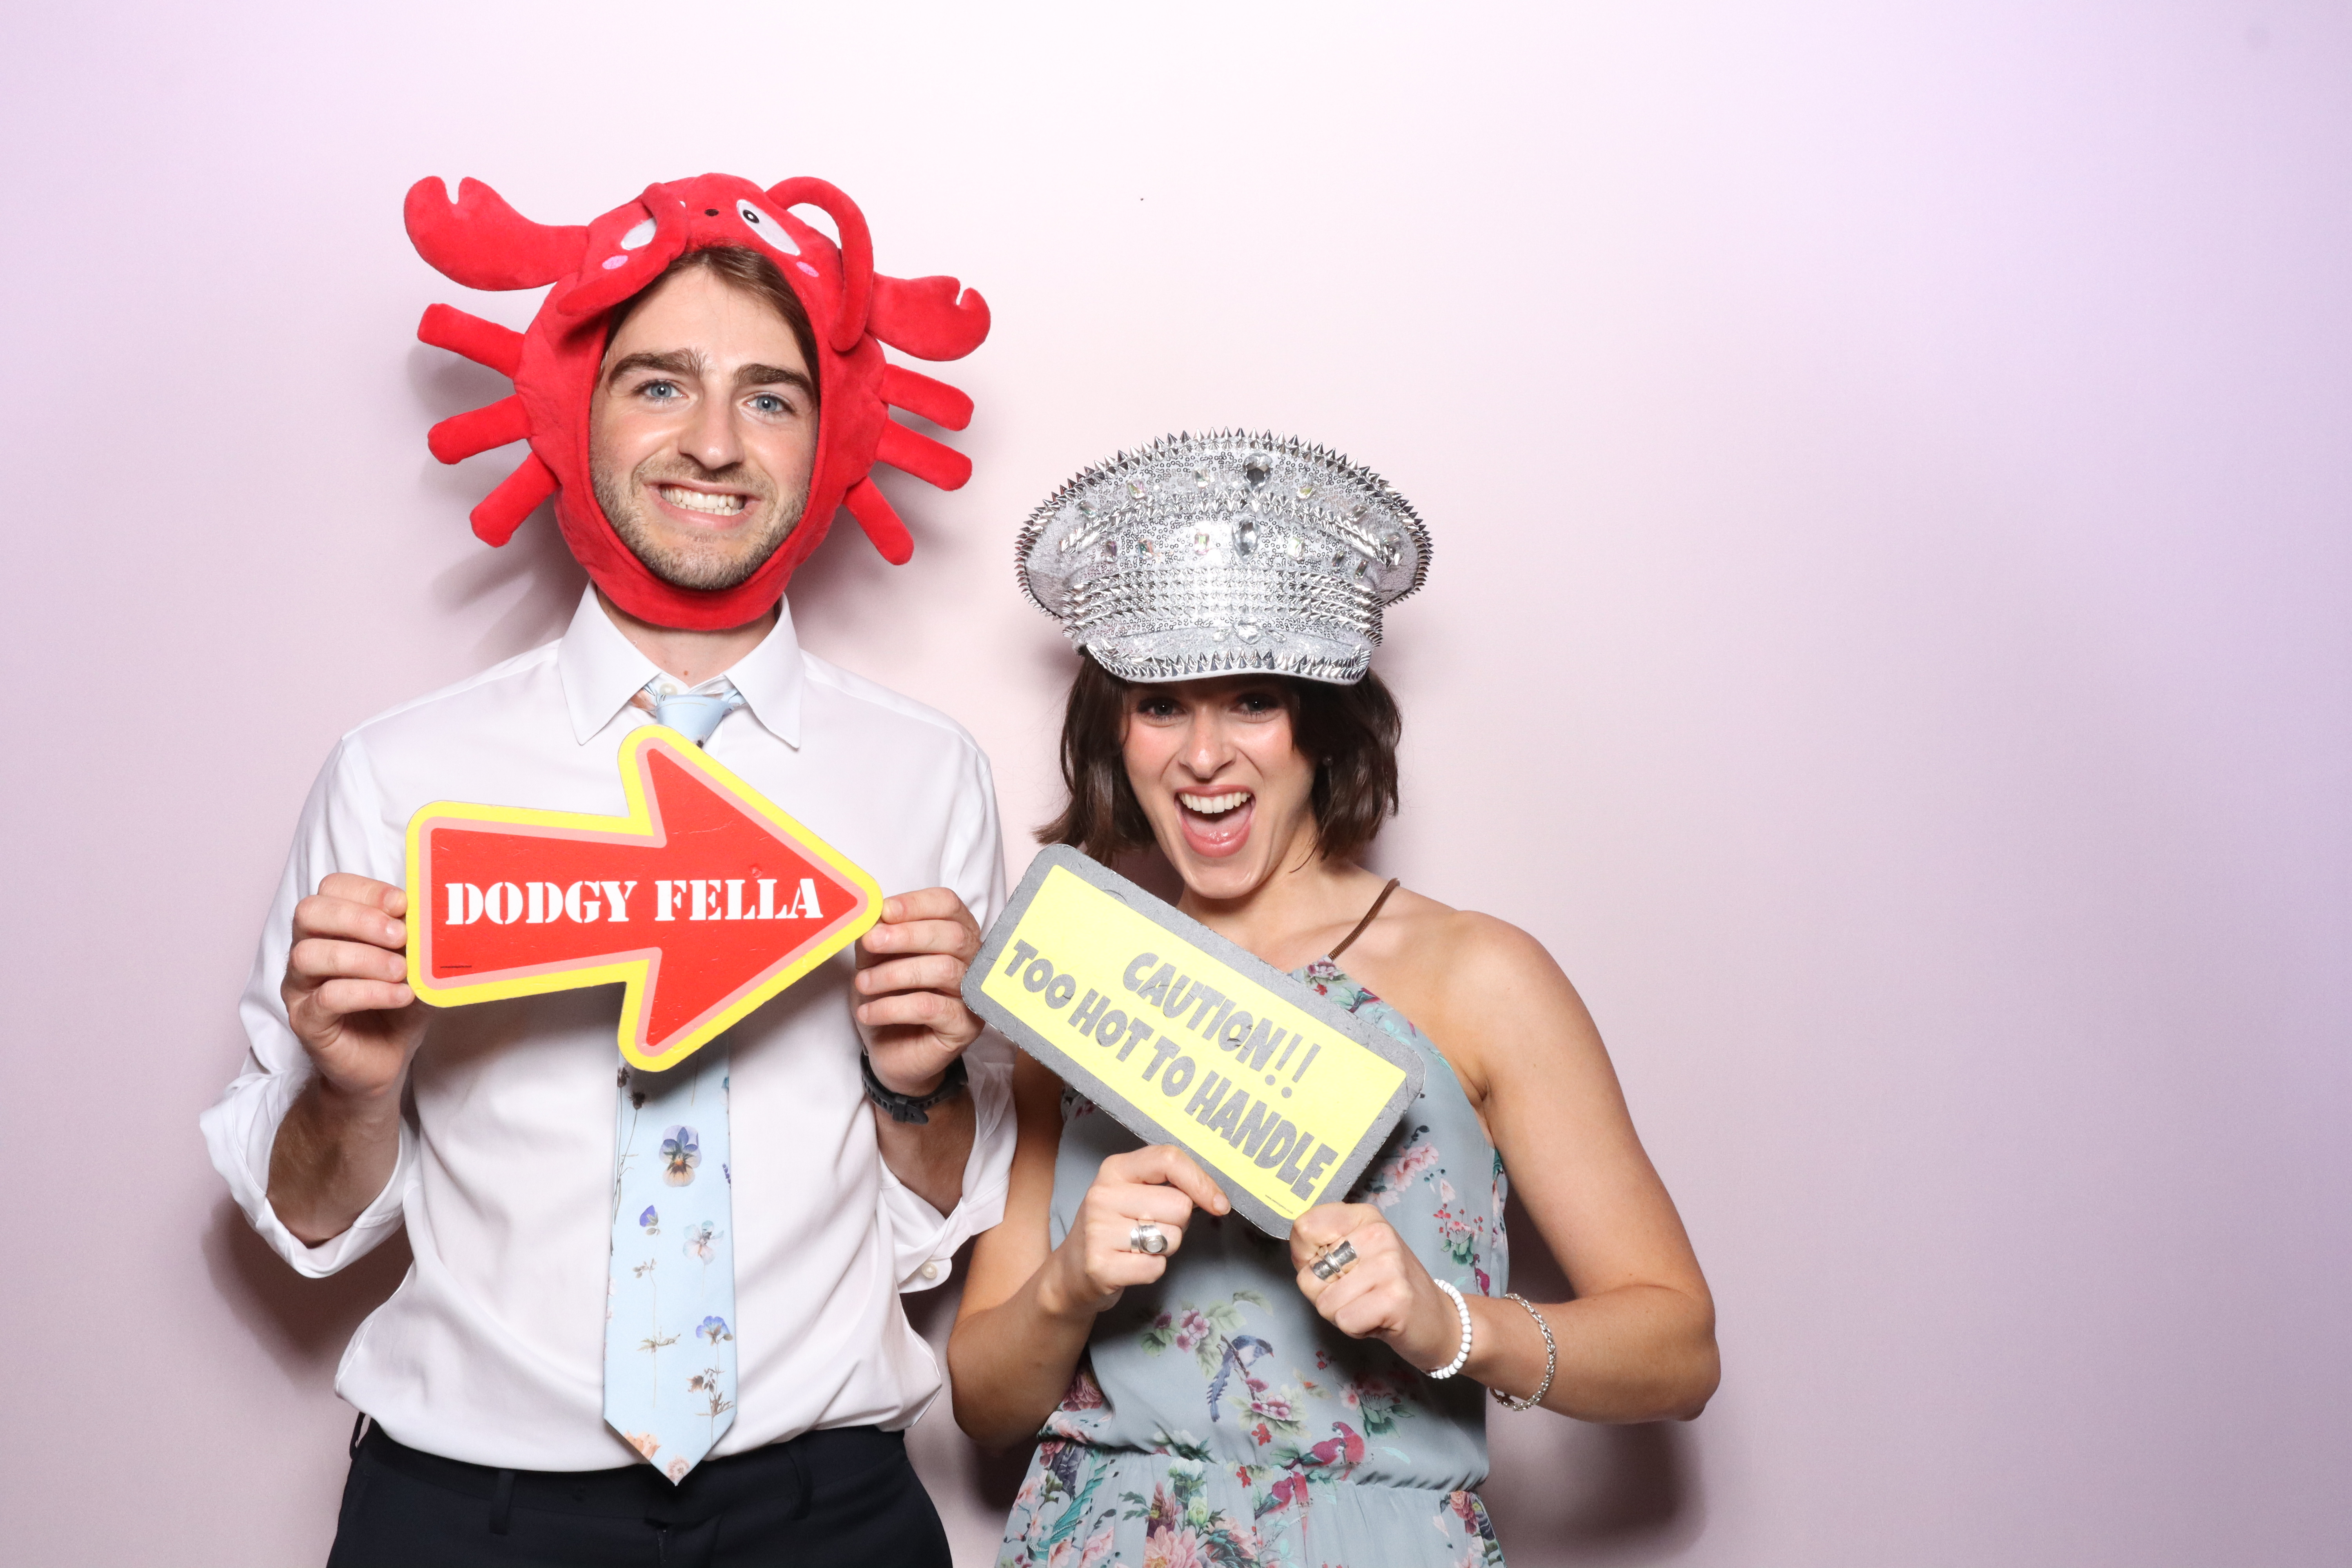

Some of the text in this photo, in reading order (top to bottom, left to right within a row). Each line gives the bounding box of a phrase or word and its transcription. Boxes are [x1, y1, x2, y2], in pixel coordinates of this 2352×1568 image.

[445, 878, 823, 925] DODGY FELLA
[1004, 939, 1339, 1201] TOO HOT TO HANDLE
[1122, 952, 1321, 1099] CAUTION!!
